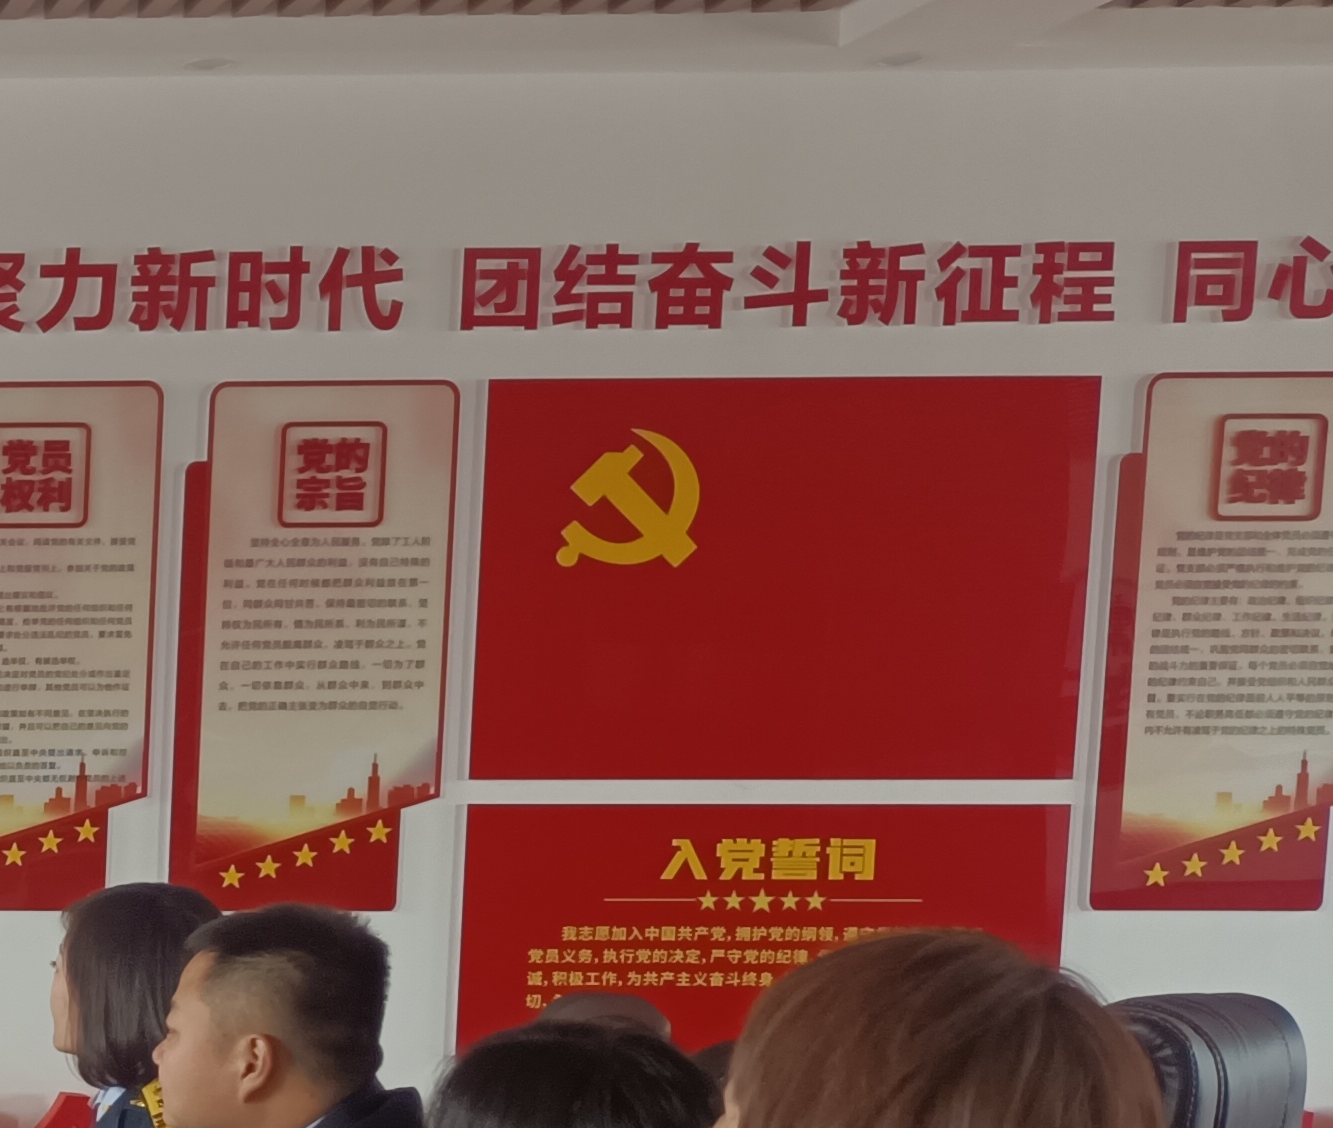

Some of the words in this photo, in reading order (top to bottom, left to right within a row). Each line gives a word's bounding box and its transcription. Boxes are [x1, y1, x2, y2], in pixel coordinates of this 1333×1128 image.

[459, 240, 1116, 332] 团结奋斗新征程
[2, 439, 72, 475] 党员
[297, 437, 371, 474] 党的
[0, 477, 72, 513] 权利
[296, 476, 367, 512] 宗旨
[660, 838, 877, 881] 入党誓词
